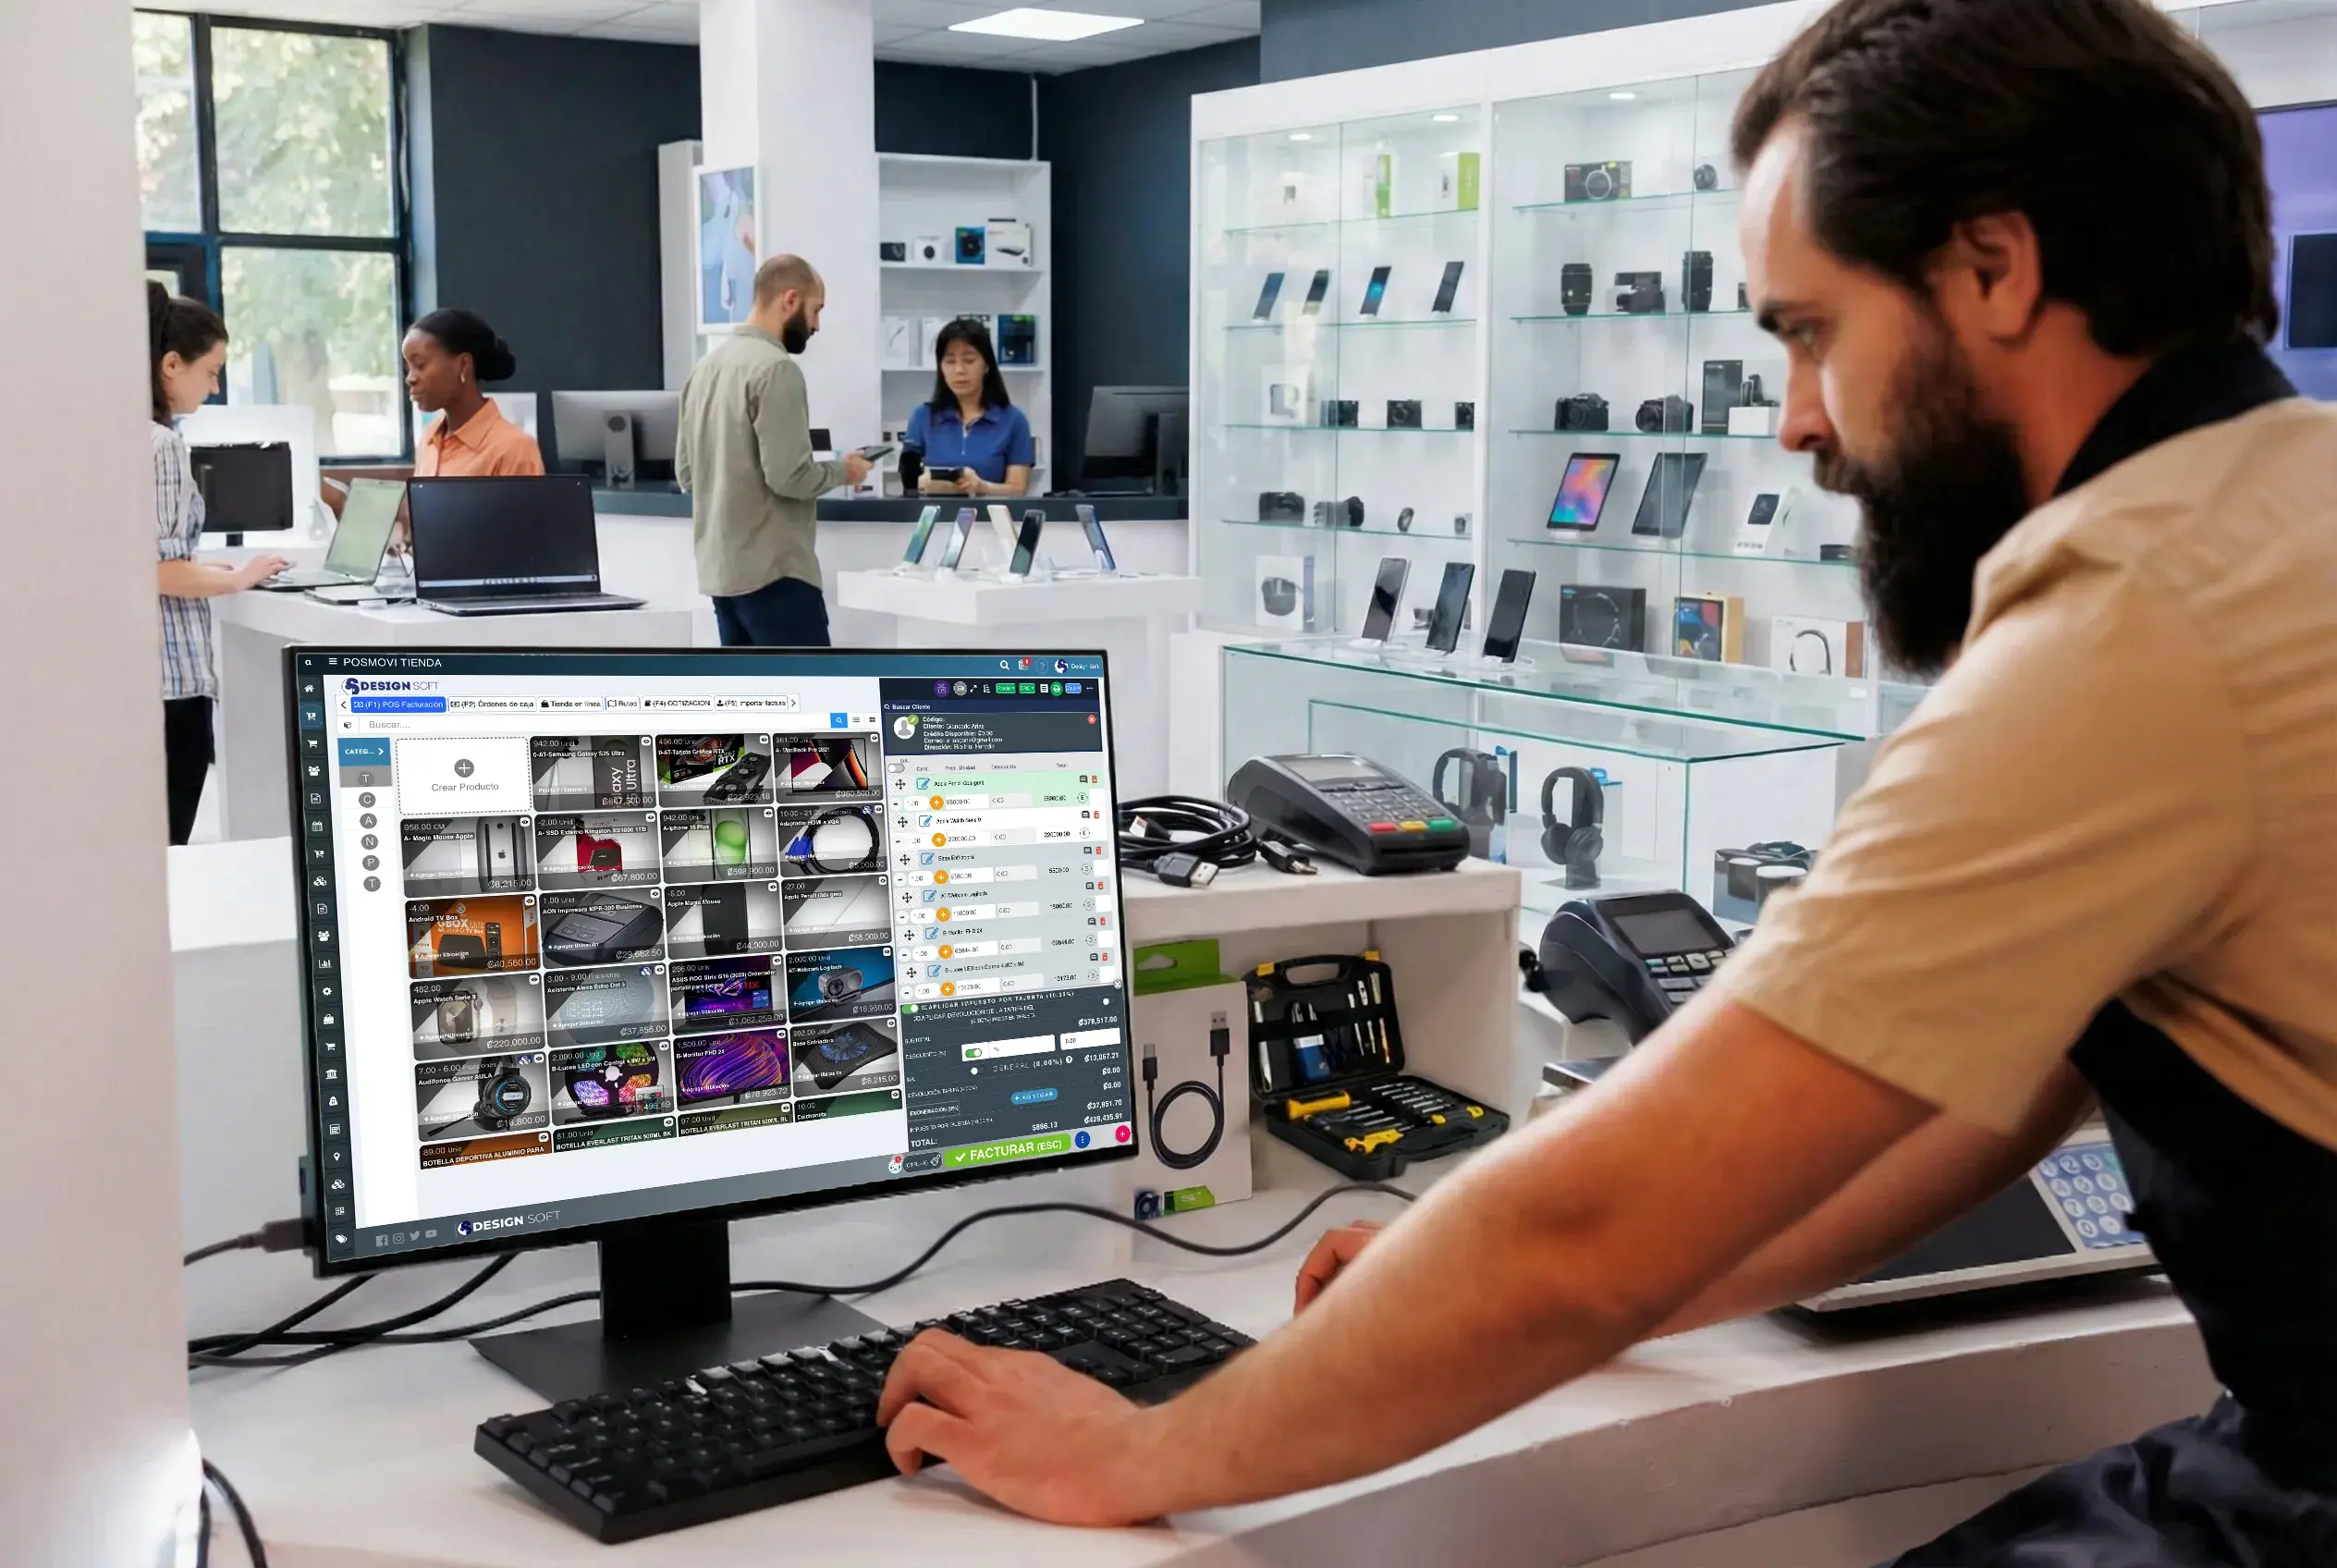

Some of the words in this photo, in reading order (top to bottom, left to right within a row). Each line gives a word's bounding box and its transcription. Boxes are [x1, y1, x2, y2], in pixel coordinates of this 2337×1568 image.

[343, 657, 398, 667] POSMOVI
[401, 658, 442, 667] TIENDA
[361, 681, 411, 691] DESIGN
[413, 681, 439, 691] SOFT
[432, 782, 456, 792] Crear
[460, 782, 499, 792] Producto
[424, 1146, 446, 1155] 89.00
[556, 1141, 585, 1150] BOTELLA
[970, 1142, 1034, 1161] FACTURAR
[1037, 1140, 1062, 1152] (ESC)
[423, 1158, 454, 1167] BOTELLA
[472, 1216, 524, 1232] DESIGN
[527, 1210, 561, 1224] SOFT
